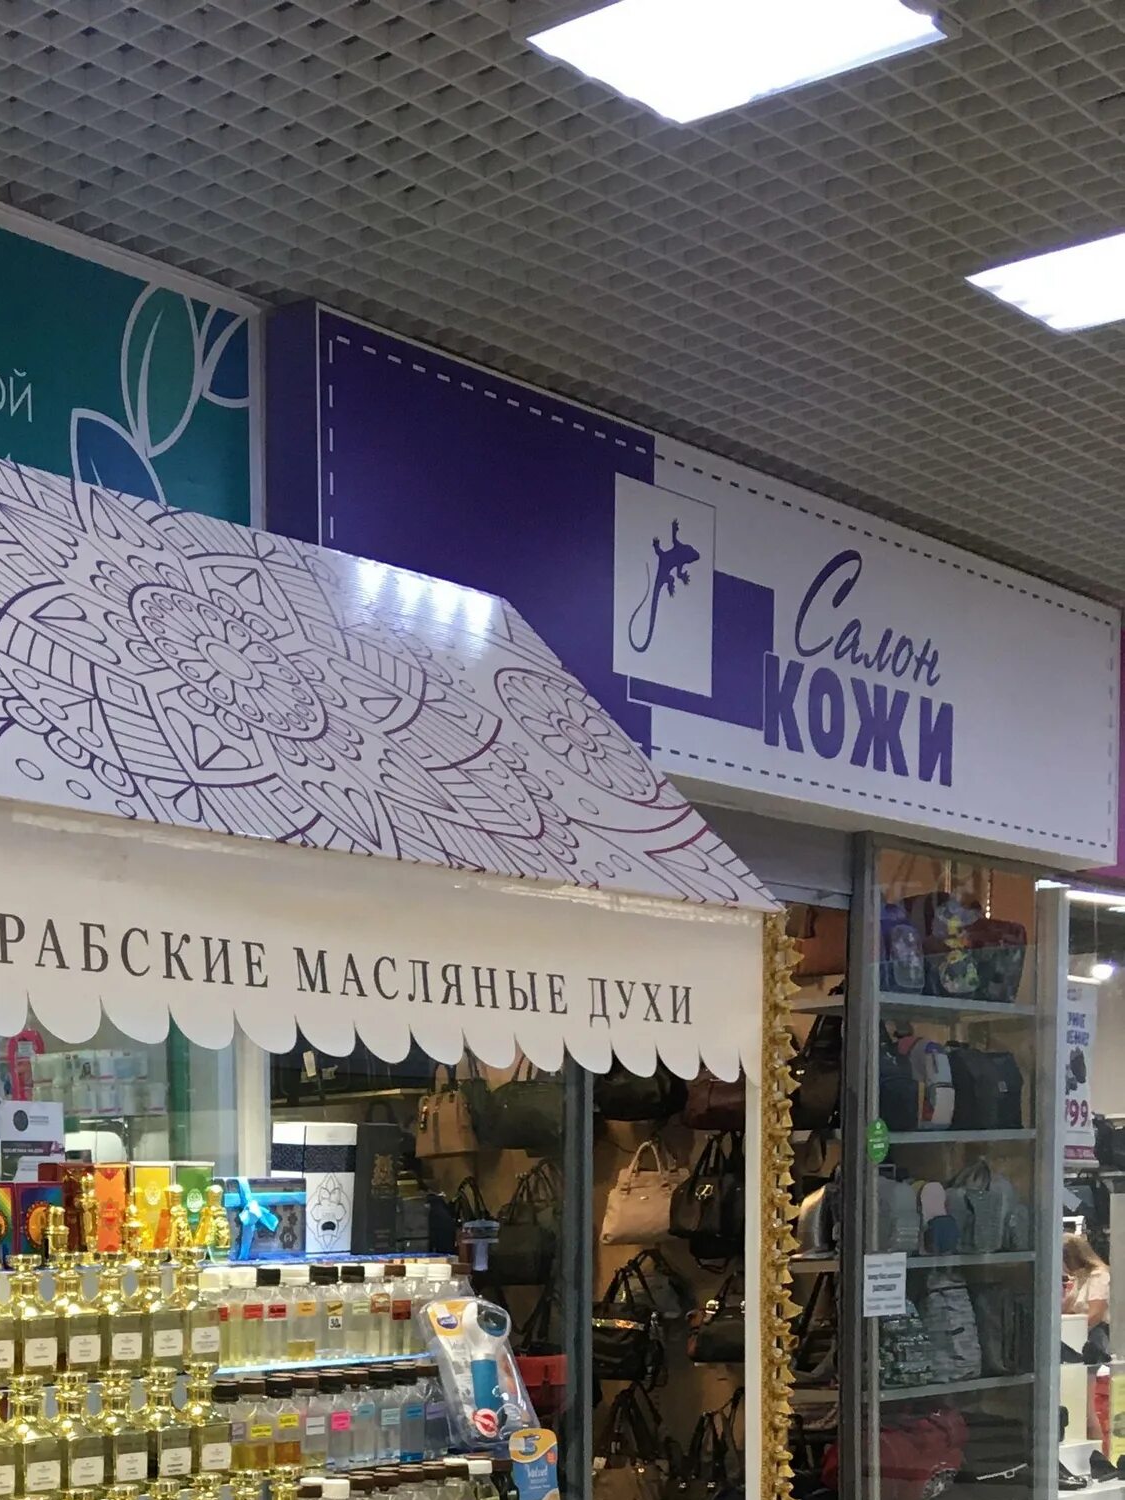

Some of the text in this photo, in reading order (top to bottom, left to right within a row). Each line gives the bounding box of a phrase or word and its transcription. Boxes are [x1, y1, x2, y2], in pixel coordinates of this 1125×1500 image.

[794, 549, 942, 687] Салон
[764, 652, 954, 788] КОЖИ
[292, 946, 569, 1015] МАСЛЯНЫЕ
[588, 976, 693, 1029] ДУХИ
